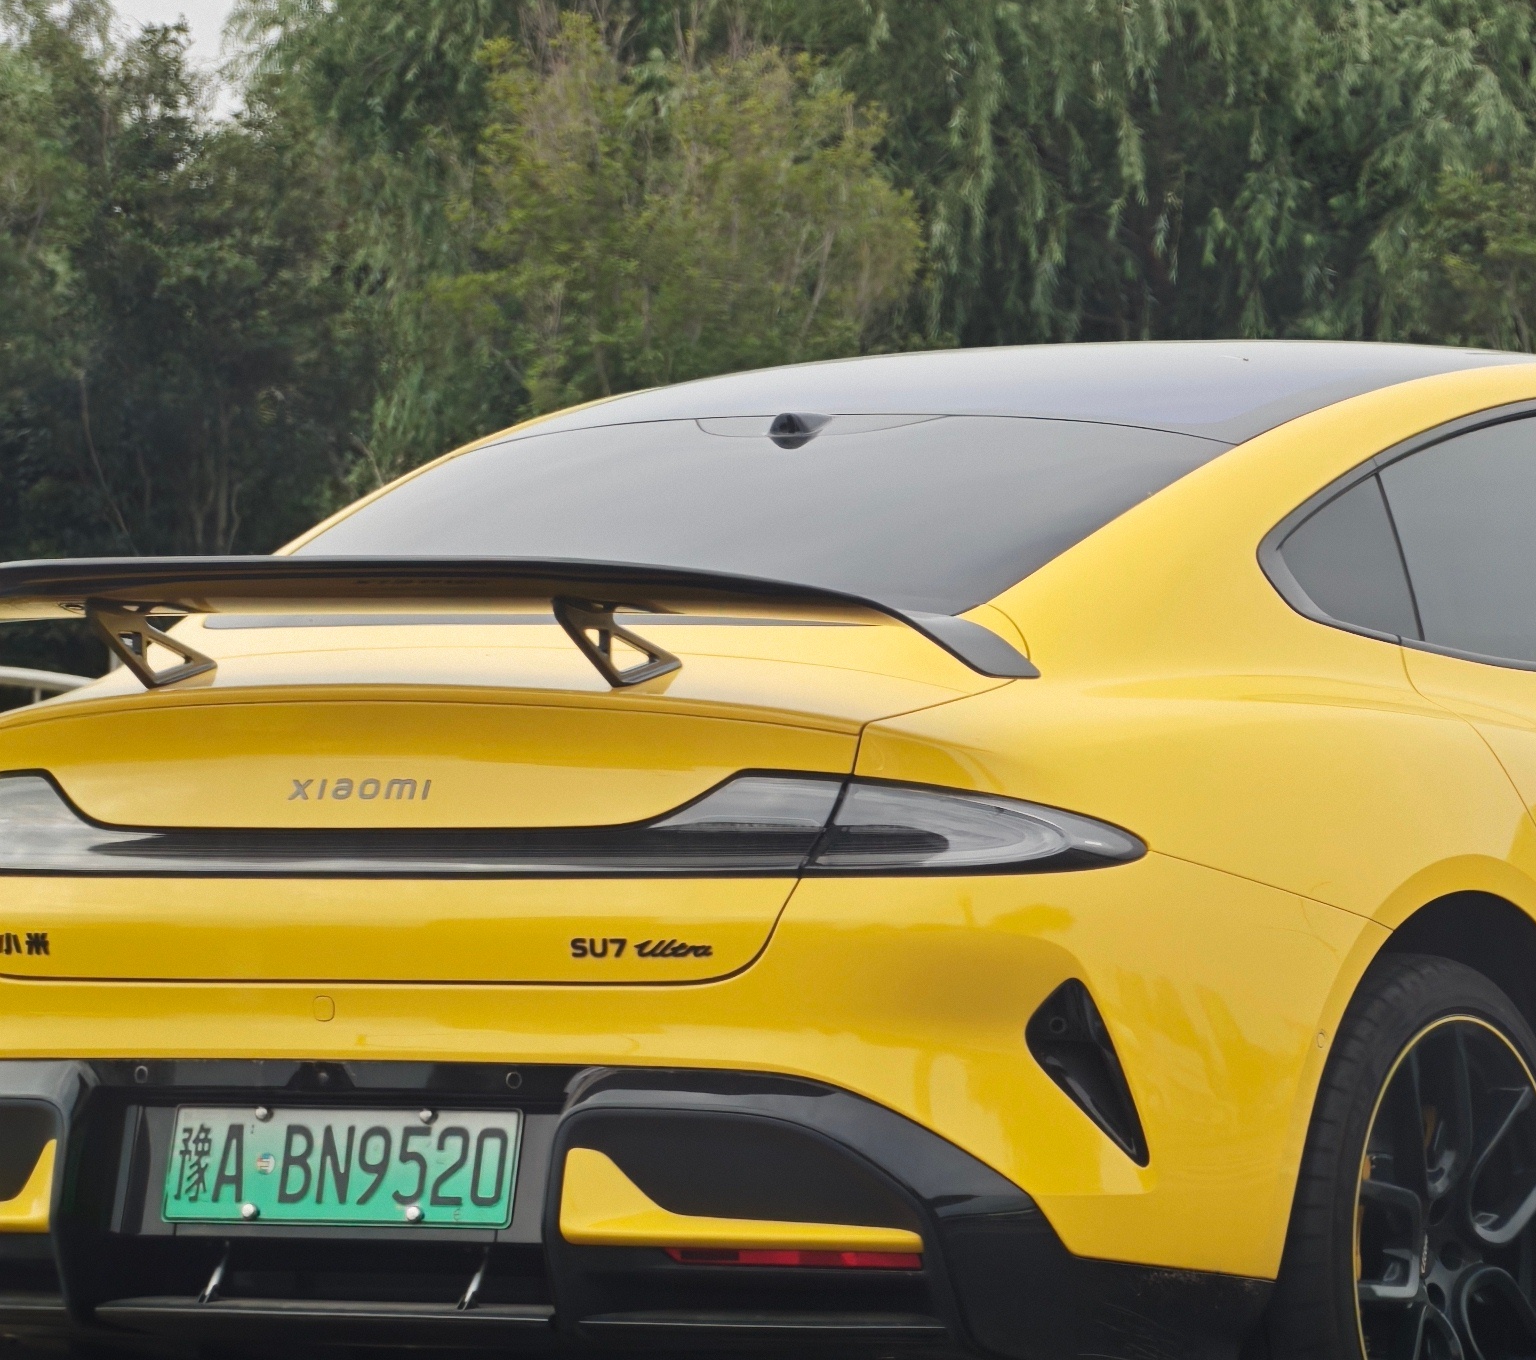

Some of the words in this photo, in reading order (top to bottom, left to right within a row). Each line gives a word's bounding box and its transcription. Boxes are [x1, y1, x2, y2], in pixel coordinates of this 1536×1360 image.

[0, 932, 50, 956] 小米
[570, 937, 627, 958] SU7
[633, 938, 713, 958] Ultra
[277, 1123, 508, 1207] BN9520
